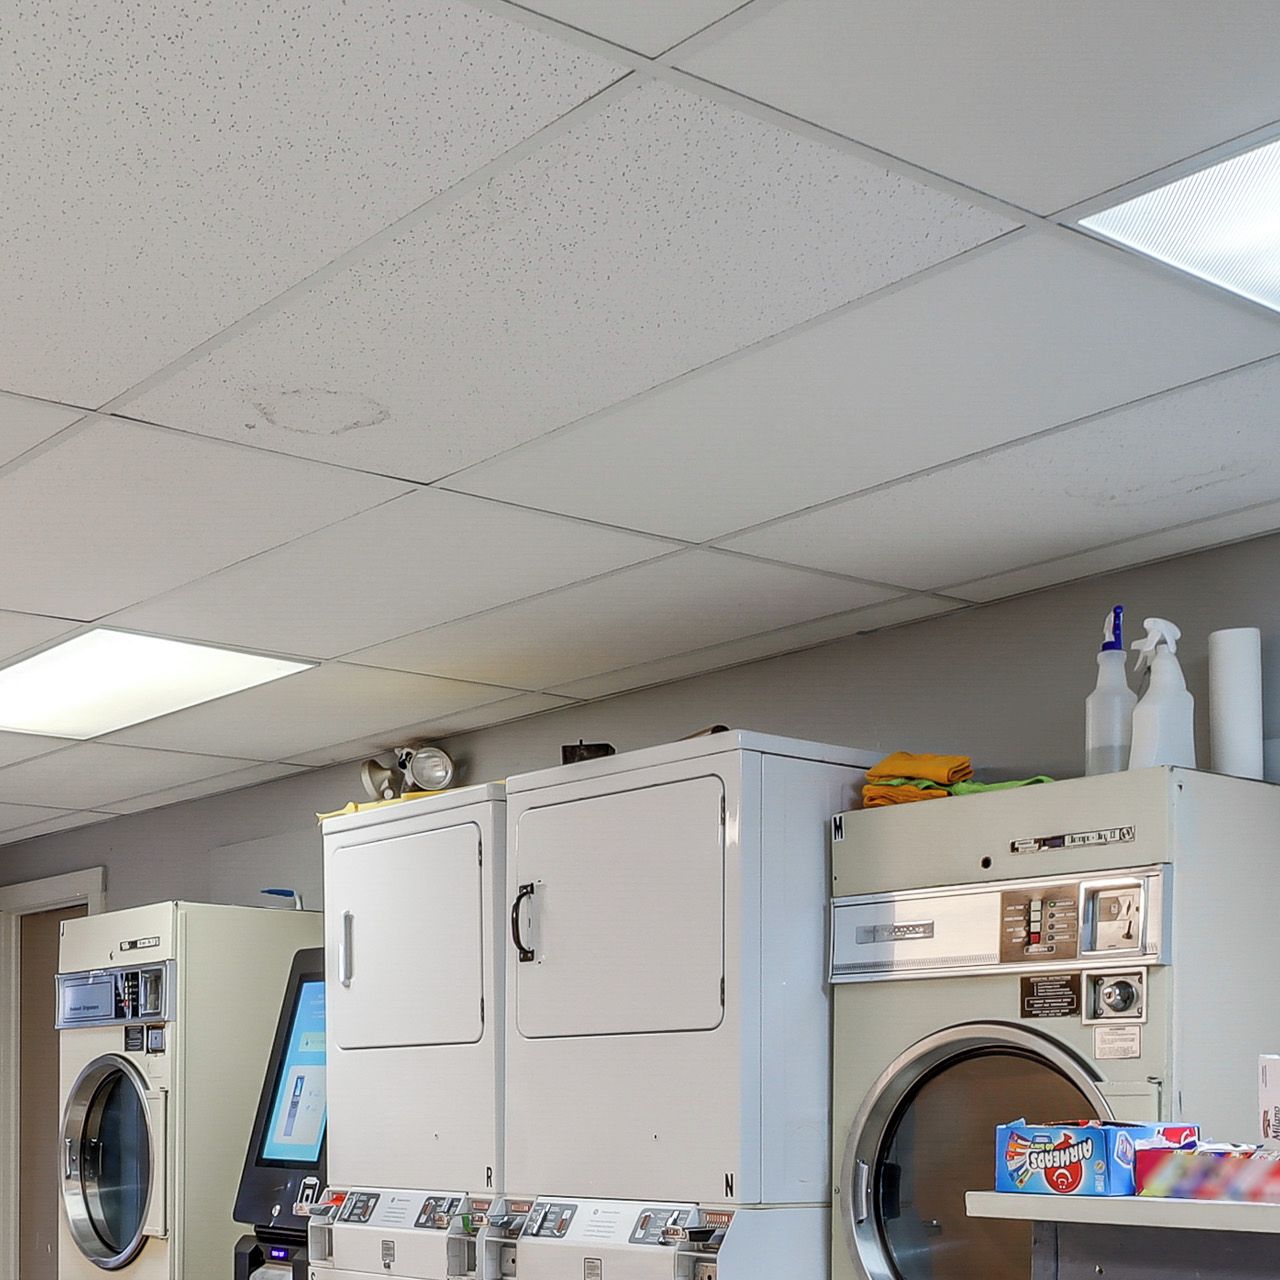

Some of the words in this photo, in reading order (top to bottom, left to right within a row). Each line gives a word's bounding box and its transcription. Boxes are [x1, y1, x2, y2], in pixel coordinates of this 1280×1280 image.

[833, 816, 844, 840] M
[1028, 1138, 1094, 1170] AIRHEADS
[486, 1166, 493, 1188] R
[724, 1173, 734, 1198] N
